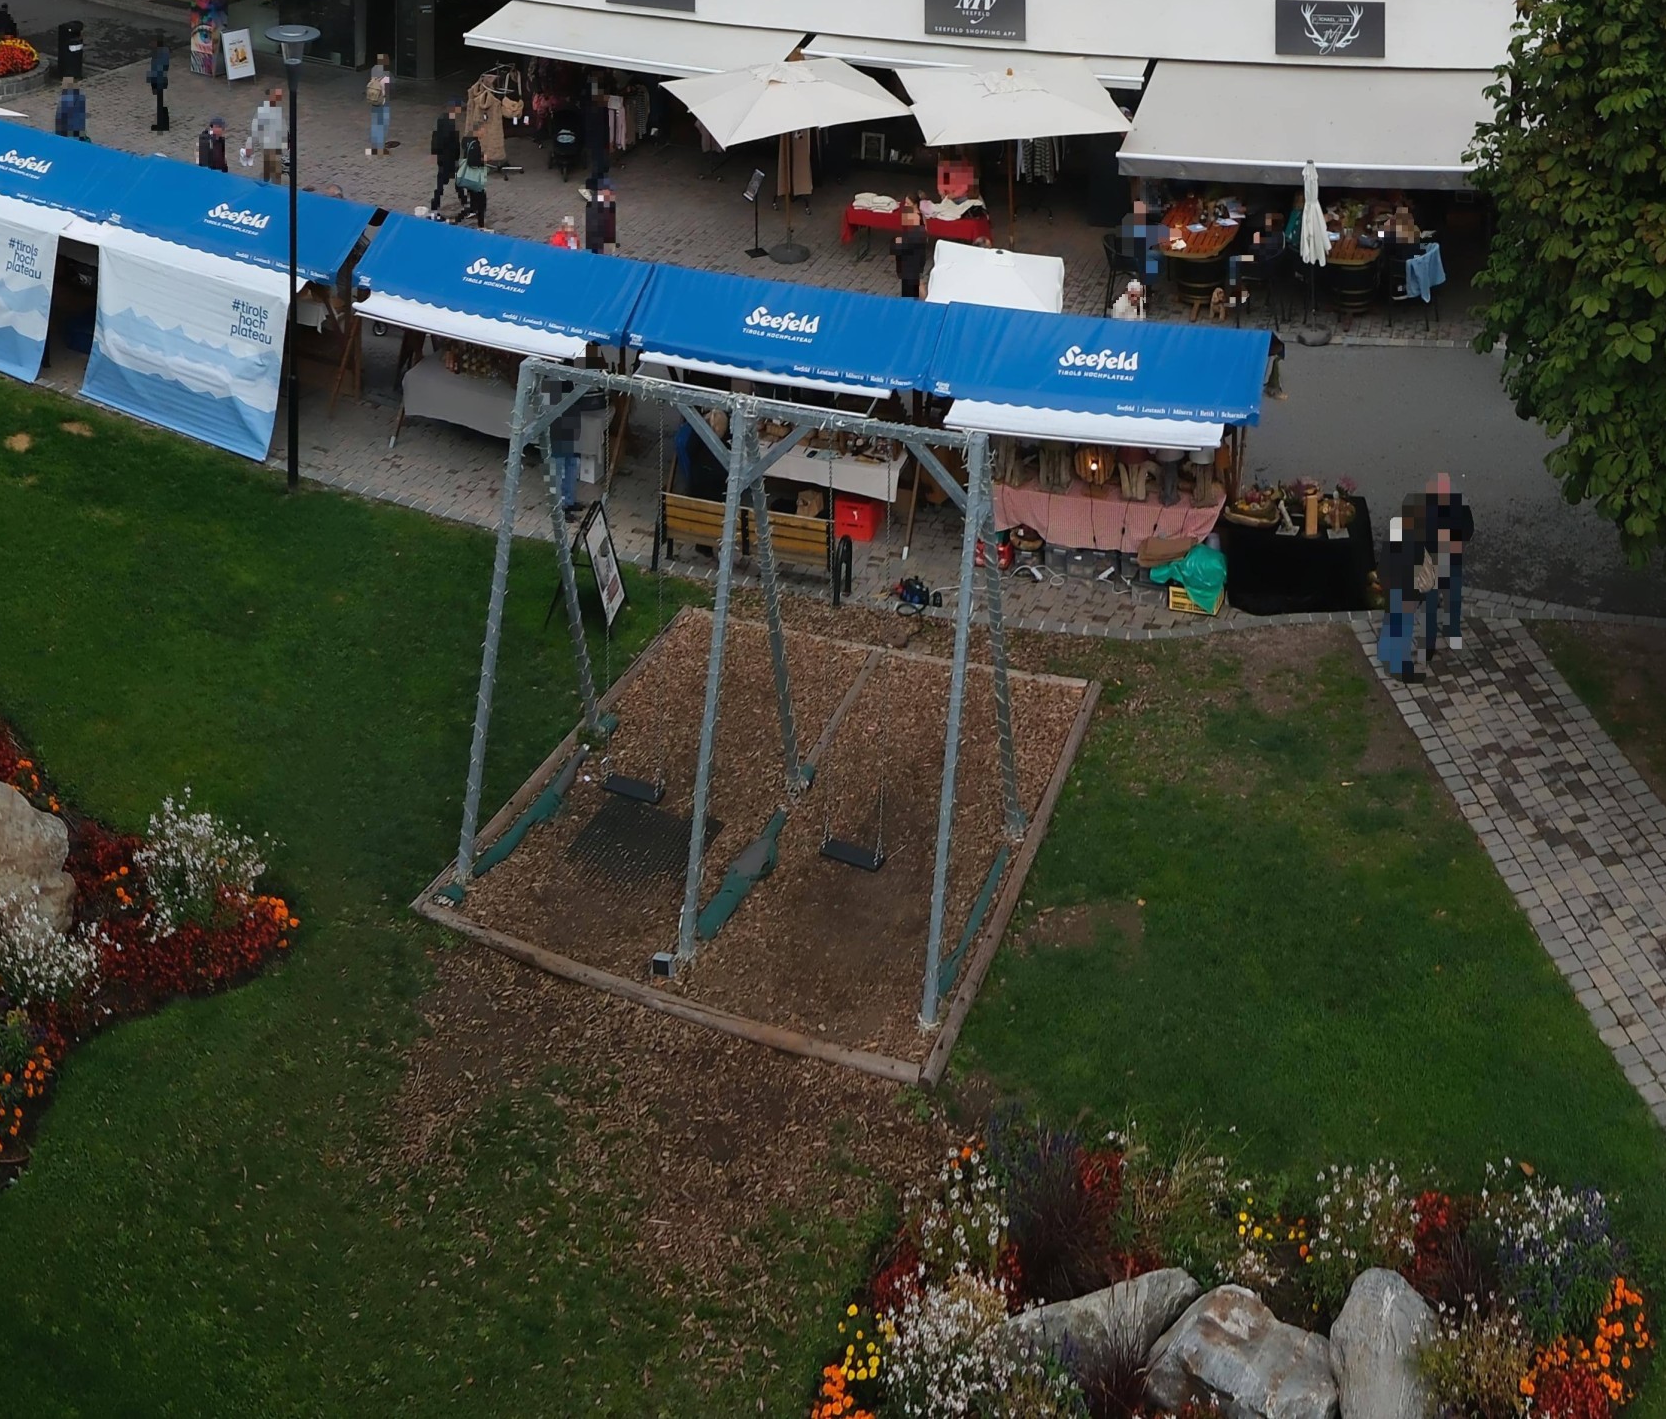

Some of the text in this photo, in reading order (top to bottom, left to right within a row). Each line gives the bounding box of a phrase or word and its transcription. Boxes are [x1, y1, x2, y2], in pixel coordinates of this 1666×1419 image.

[934, 26, 964, 34] SEEFELD
[966, 28, 1001, 36] SHOPPING
[208, 202, 270, 229] Seefeld
[8, 237, 39, 257] #tirols
[14, 249, 35, 267] hoch
[6, 260, 42, 280] plateau
[466, 257, 536, 286] Seefeld
[232, 299, 269, 320] #tirols
[240, 312, 266, 331] hoch
[745, 306, 820, 334] Seefeld
[230, 323, 273, 346] plateau
[1058, 345, 1139, 372] Seefeld
[1058, 369, 1134, 382] TIROLS HOCHPLATEAU
